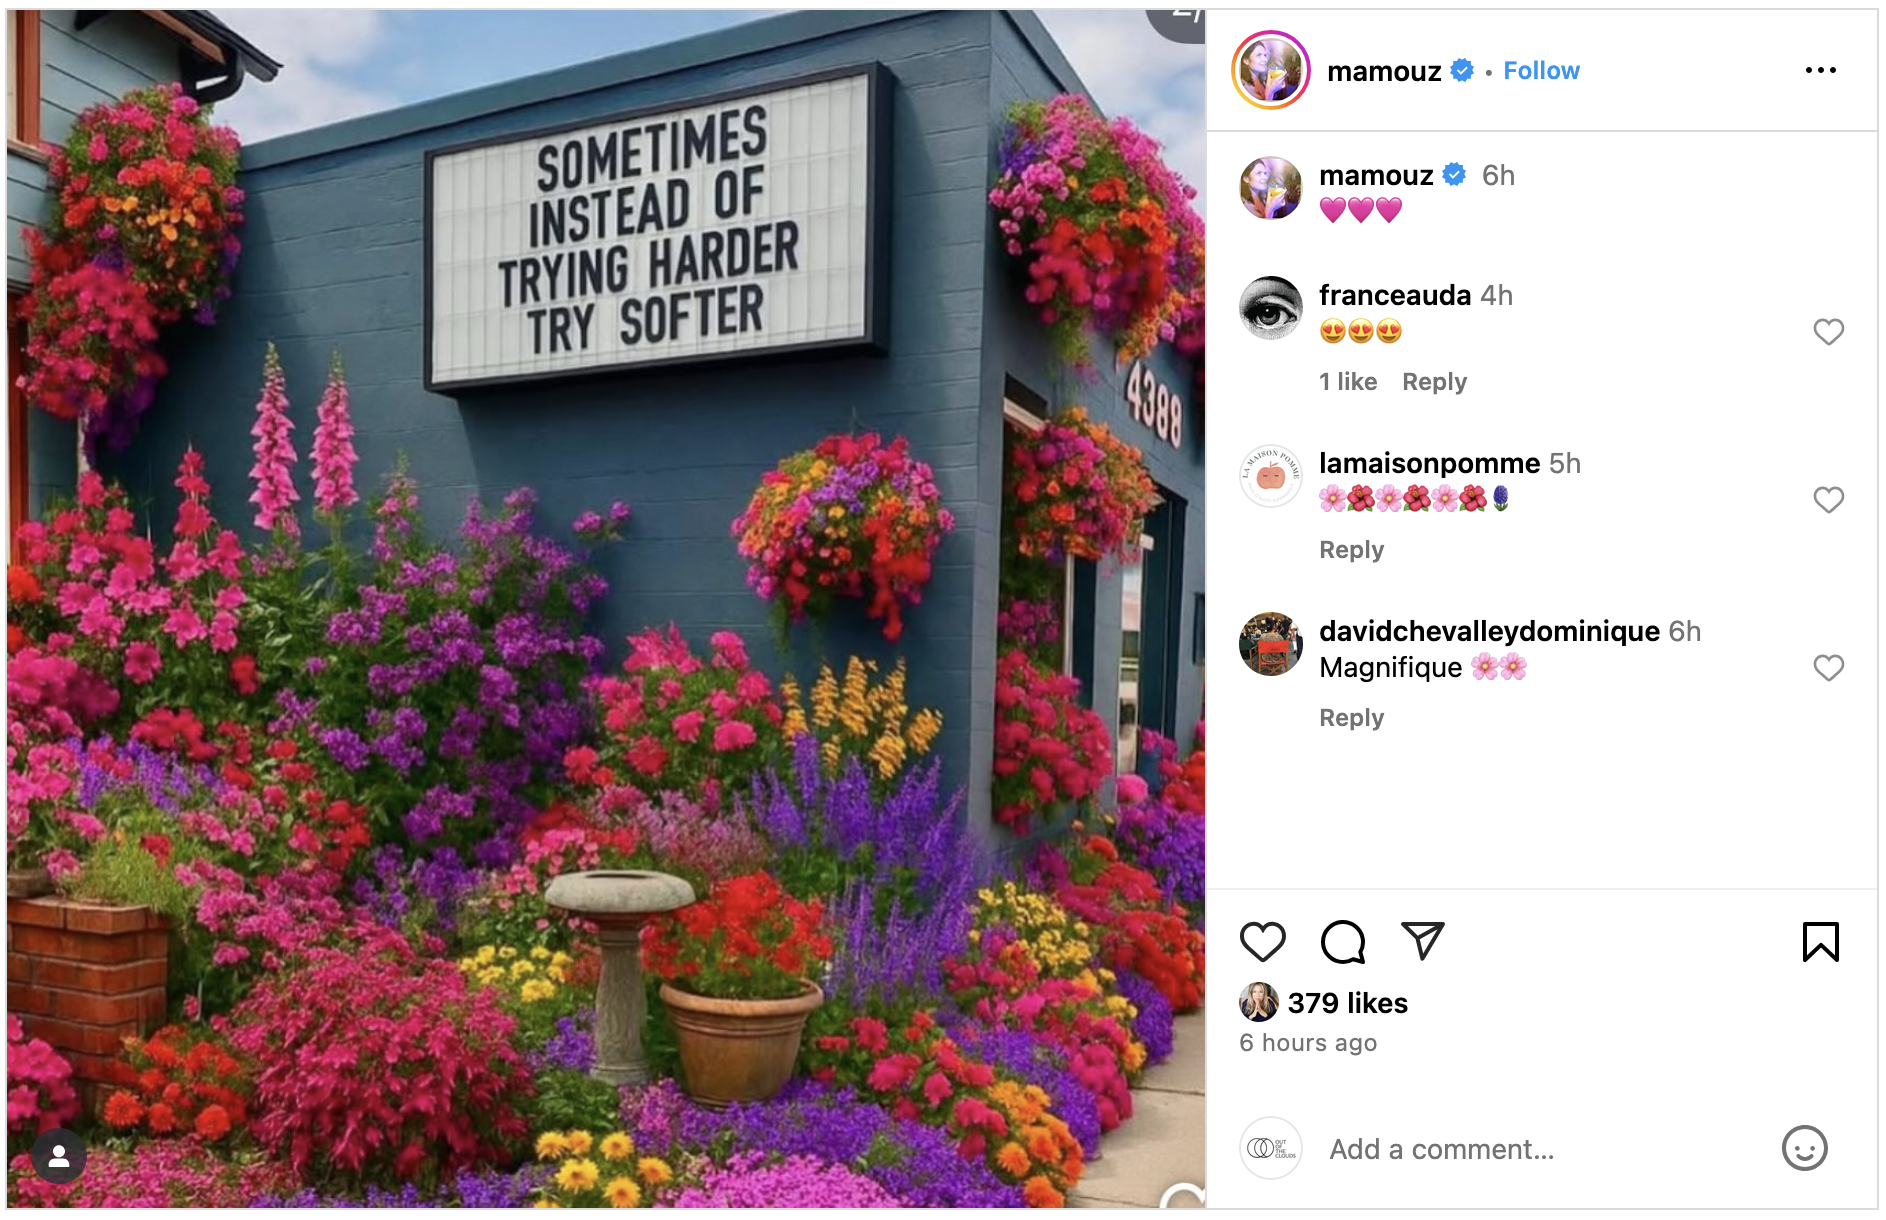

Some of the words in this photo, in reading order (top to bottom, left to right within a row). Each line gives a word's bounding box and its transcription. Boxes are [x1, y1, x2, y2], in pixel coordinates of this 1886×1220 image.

[1328, 64, 1442, 83] mamouz
[1504, 59, 1581, 80] Follow
[537, 105, 767, 193] SOMETIMES
[1320, 168, 1434, 187] mamouz
[1482, 163, 1515, 187] 6h
[530, 178, 690, 248] INSTEAD
[715, 164, 765, 220] OF
[498, 245, 628, 308] TRYING
[649, 220, 799, 289] HARDER
[1319, 282, 1472, 307] franceauda
[1480, 283, 1513, 306] 4h
[526, 303, 595, 355] TRY
[620, 283, 764, 346] SOFTER
[1319, 372, 1329, 391] 1
[1338, 370, 1378, 391] like
[1403, 371, 1468, 396] Reply
[1127, 359, 1182, 450] 4388
[1247, 450, 1279, 467] MAISON
[1280, 453, 1300, 479] POMME
[1320, 450, 1541, 479] lamaisonpomme
[1549, 451, 1581, 475] 5h
[1320, 539, 1385, 564] Reply
[1319, 618, 1661, 648] davidchevalleydominique
[1668, 619, 1701, 643] 6h
[1320, 655, 1463, 683] Magnifique
[1320, 707, 1385, 732] Reply
[1287, 991, 1339, 1015] 379
[1348, 990, 1409, 1015] likes
[1239, 1032, 1254, 1053] 6
[1262, 1032, 1327, 1053] hours
[1335, 1037, 1378, 1057] ago
[1329, 1137, 1380, 1160] Add
[1388, 1142, 1403, 1160] a
